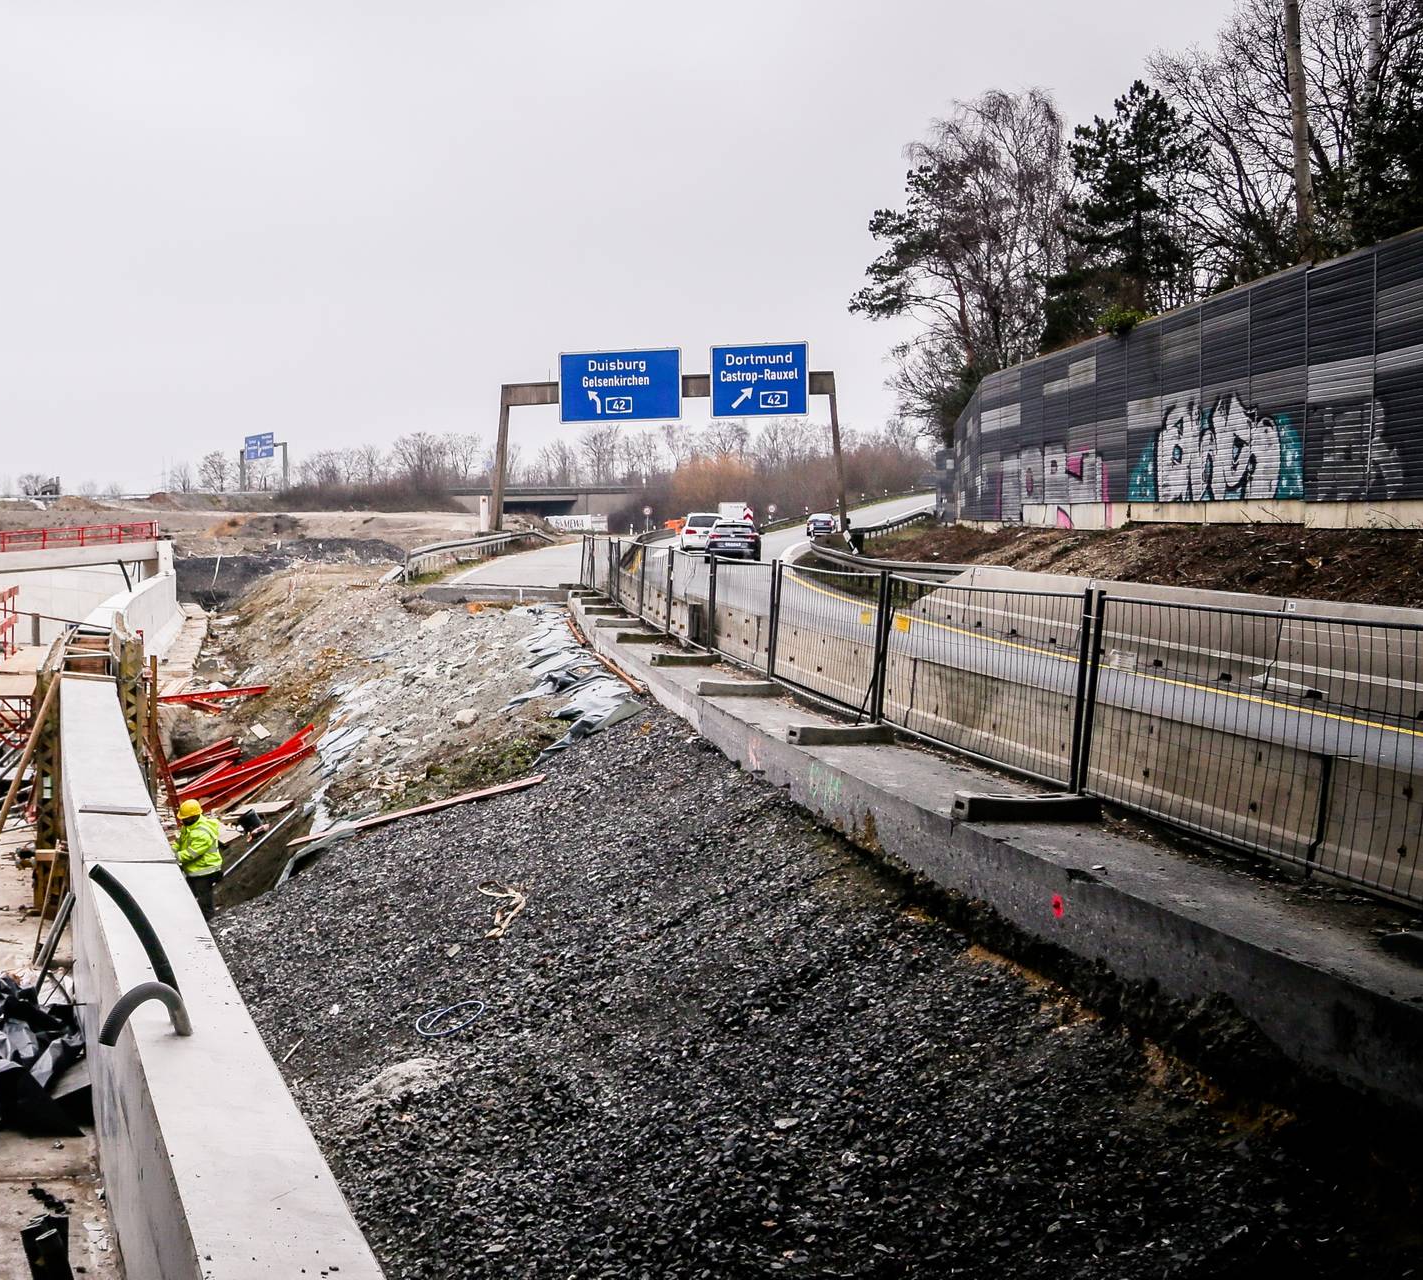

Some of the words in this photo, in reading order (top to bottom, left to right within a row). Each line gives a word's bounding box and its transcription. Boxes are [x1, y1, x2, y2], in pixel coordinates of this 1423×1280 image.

[588, 358, 646, 373] Duisburg
[725, 351, 792, 366] Dortmund
[582, 374, 650, 388] Gelsenkirchen
[720, 368, 798, 384] Castrop-Rauxel
[612, 400, 626, 410] 42
[767, 394, 781, 405] 42
